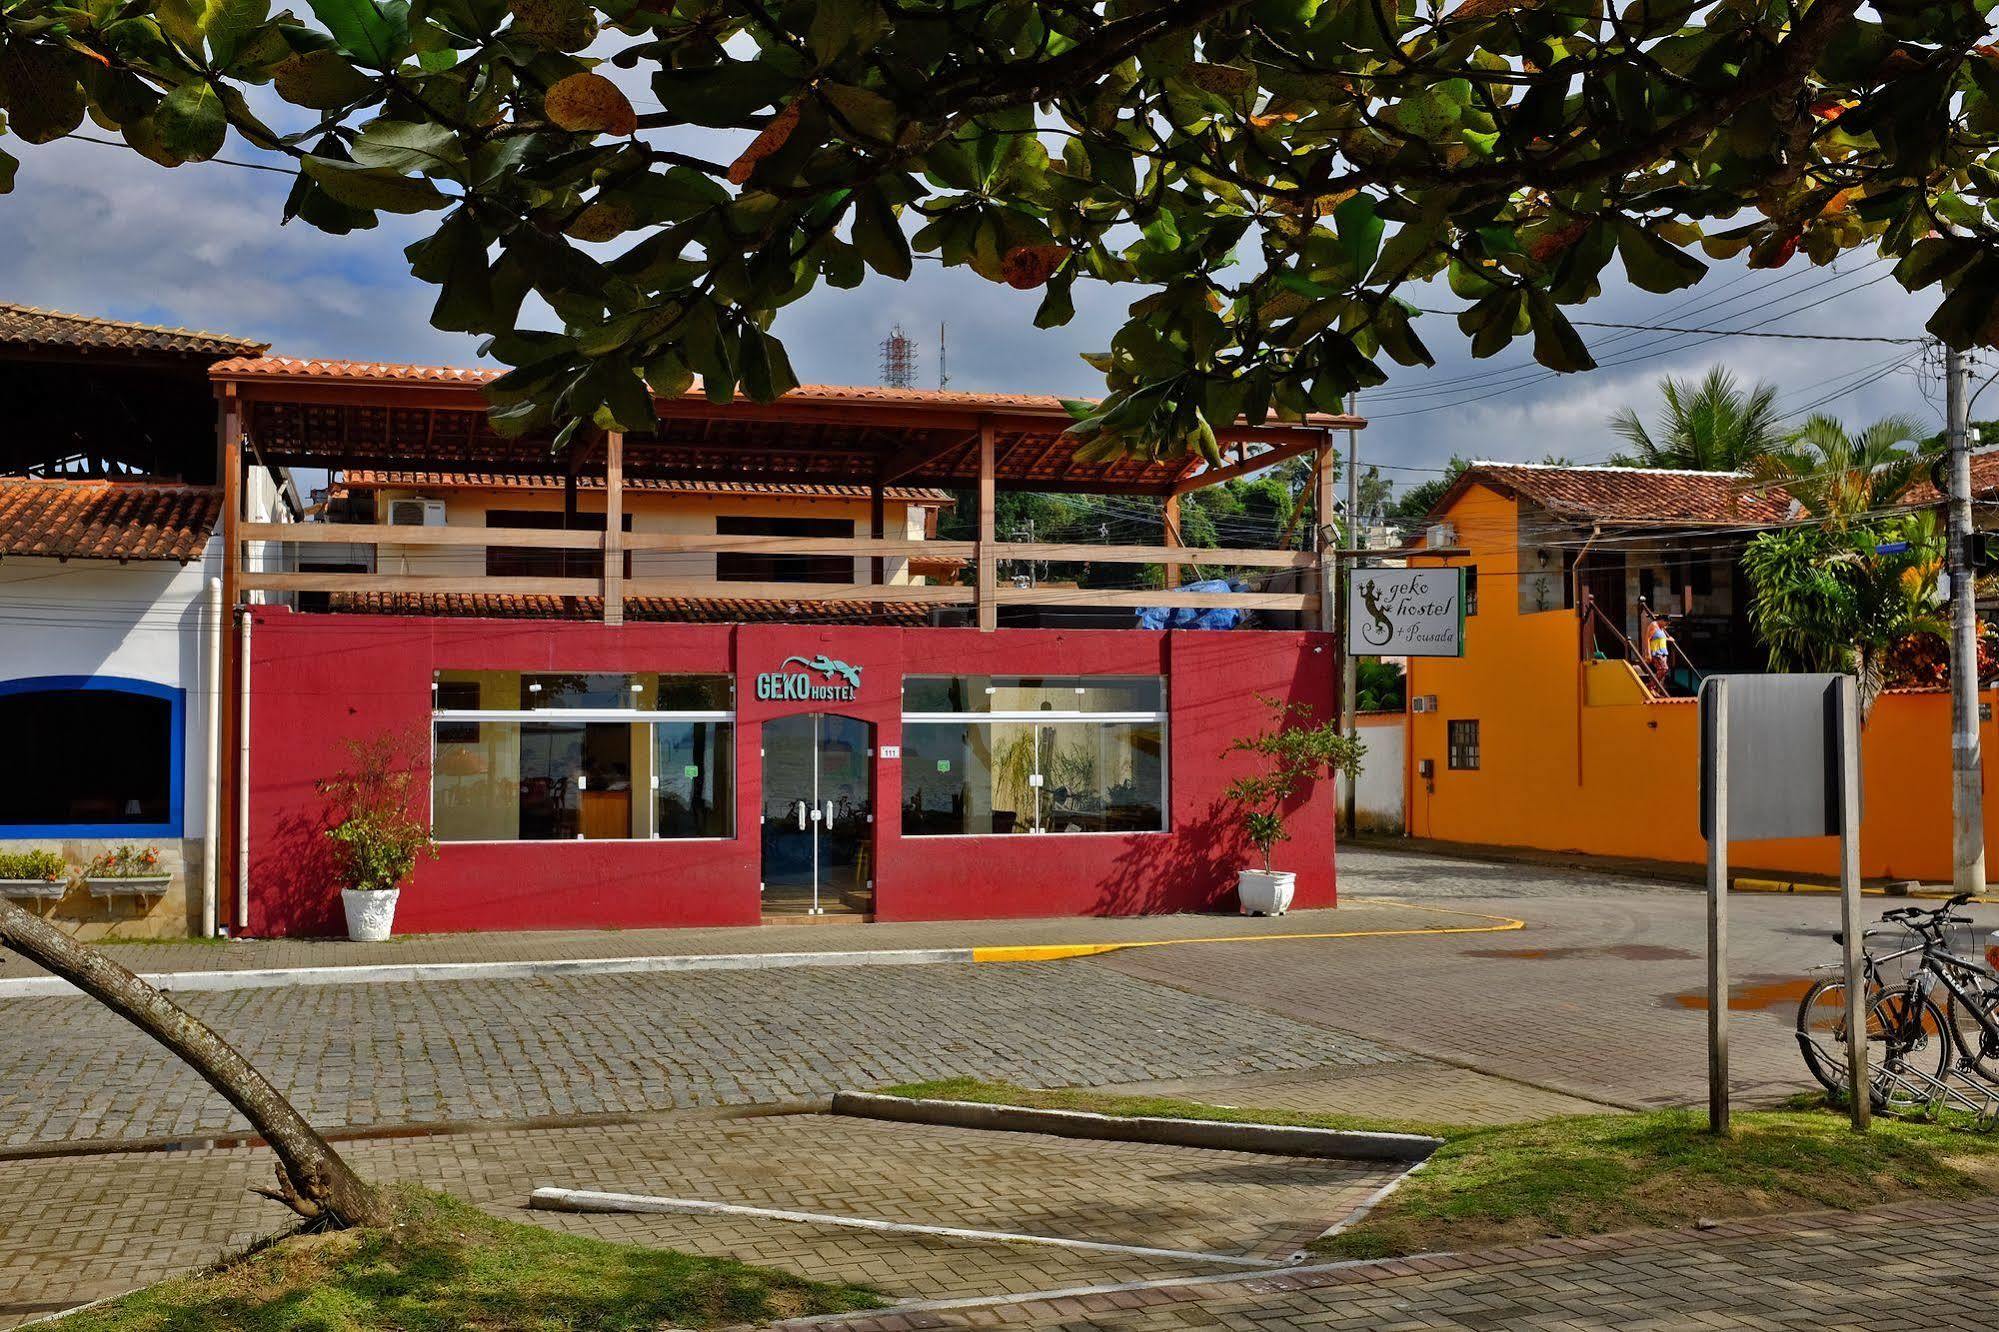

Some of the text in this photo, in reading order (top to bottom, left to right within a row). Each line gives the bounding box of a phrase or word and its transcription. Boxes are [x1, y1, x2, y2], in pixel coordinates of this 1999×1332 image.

[1384, 574, 1429, 603] geko
[1396, 597, 1454, 616] hostel
[1407, 622, 1454, 642] Pousada
[757, 672, 856, 700] GEKO HOSTEL
[884, 749, 897, 757] 111
